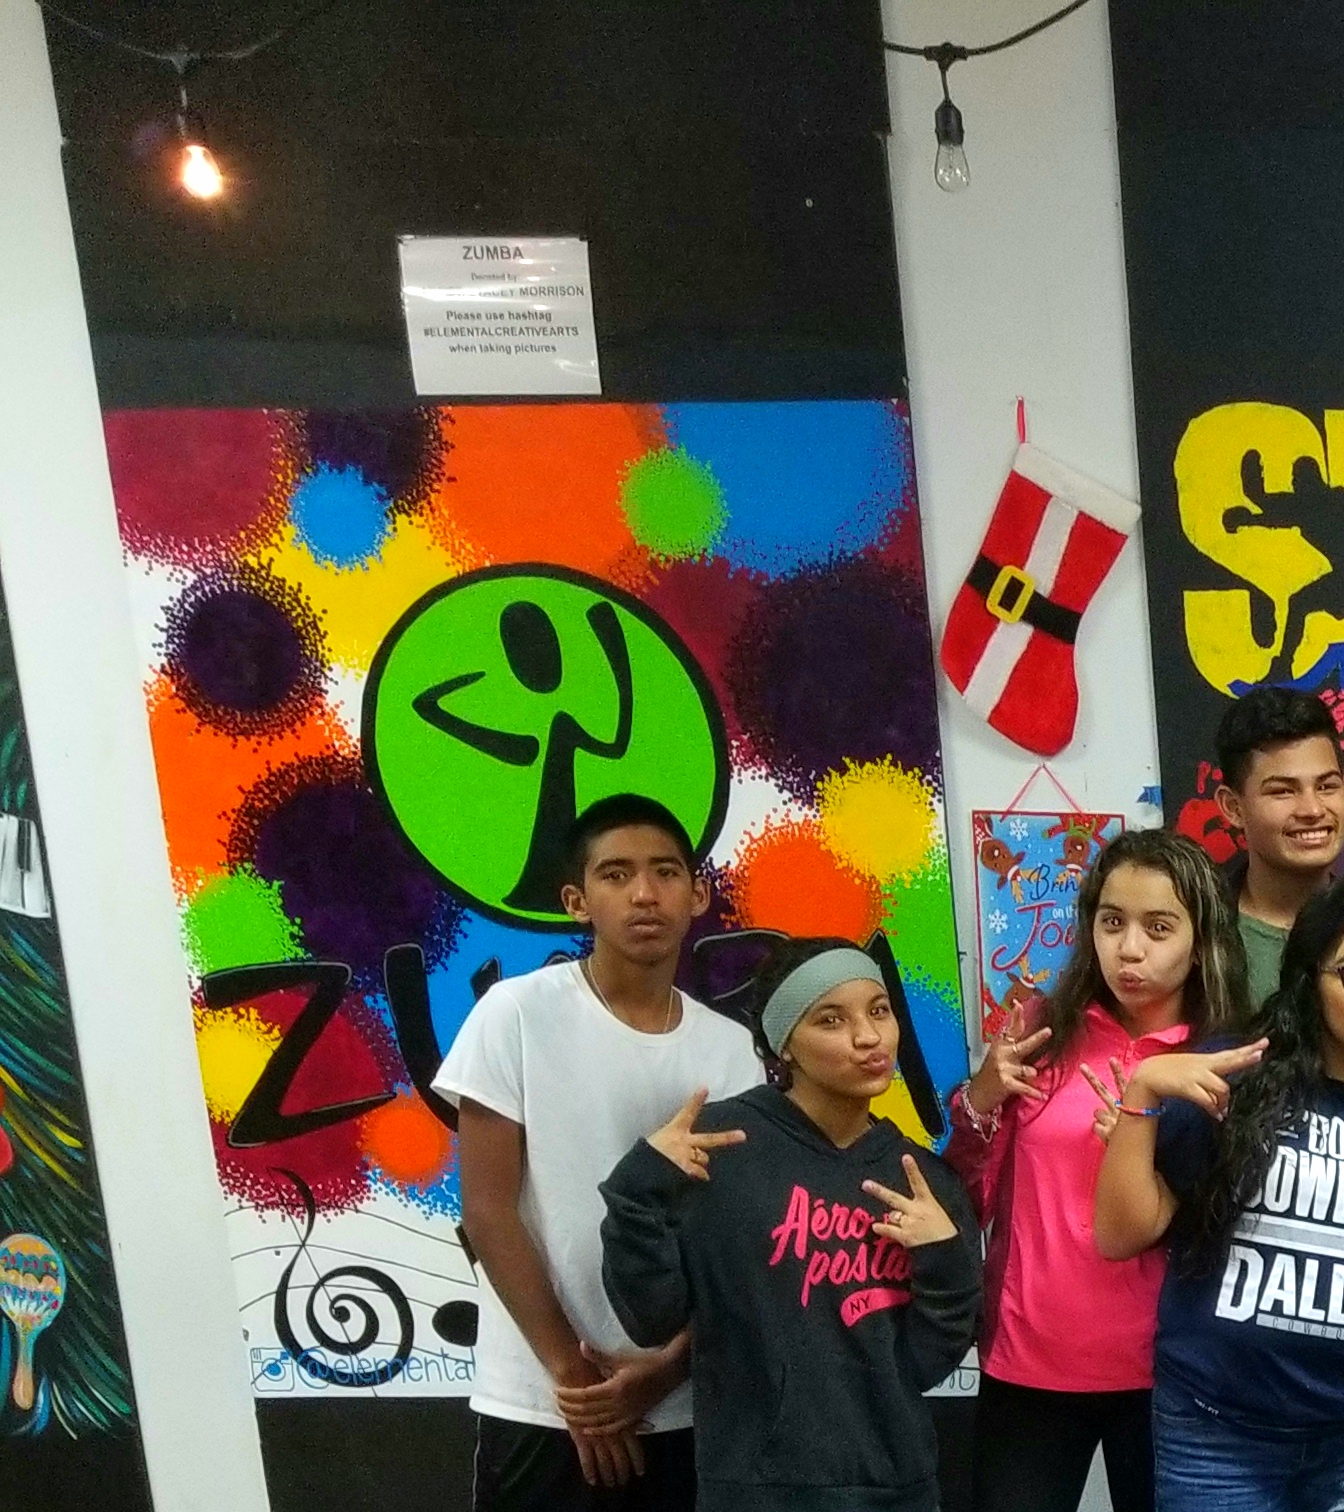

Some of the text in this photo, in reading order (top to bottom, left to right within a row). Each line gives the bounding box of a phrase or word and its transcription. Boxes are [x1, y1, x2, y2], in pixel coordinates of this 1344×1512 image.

[462, 245, 525, 260] ZUMBA
[519, 286, 585, 297] MORRISON
[446, 310, 552, 322] Please use hashtag
[423, 326, 580, 337] #ELEMENTALCREATIVEARTS
[449, 344, 557, 355] when taking pictures
[1028, 863, 1078, 901] Brin
[801, 1238, 913, 1308] posta
[850, 1297, 870, 1315] NY
